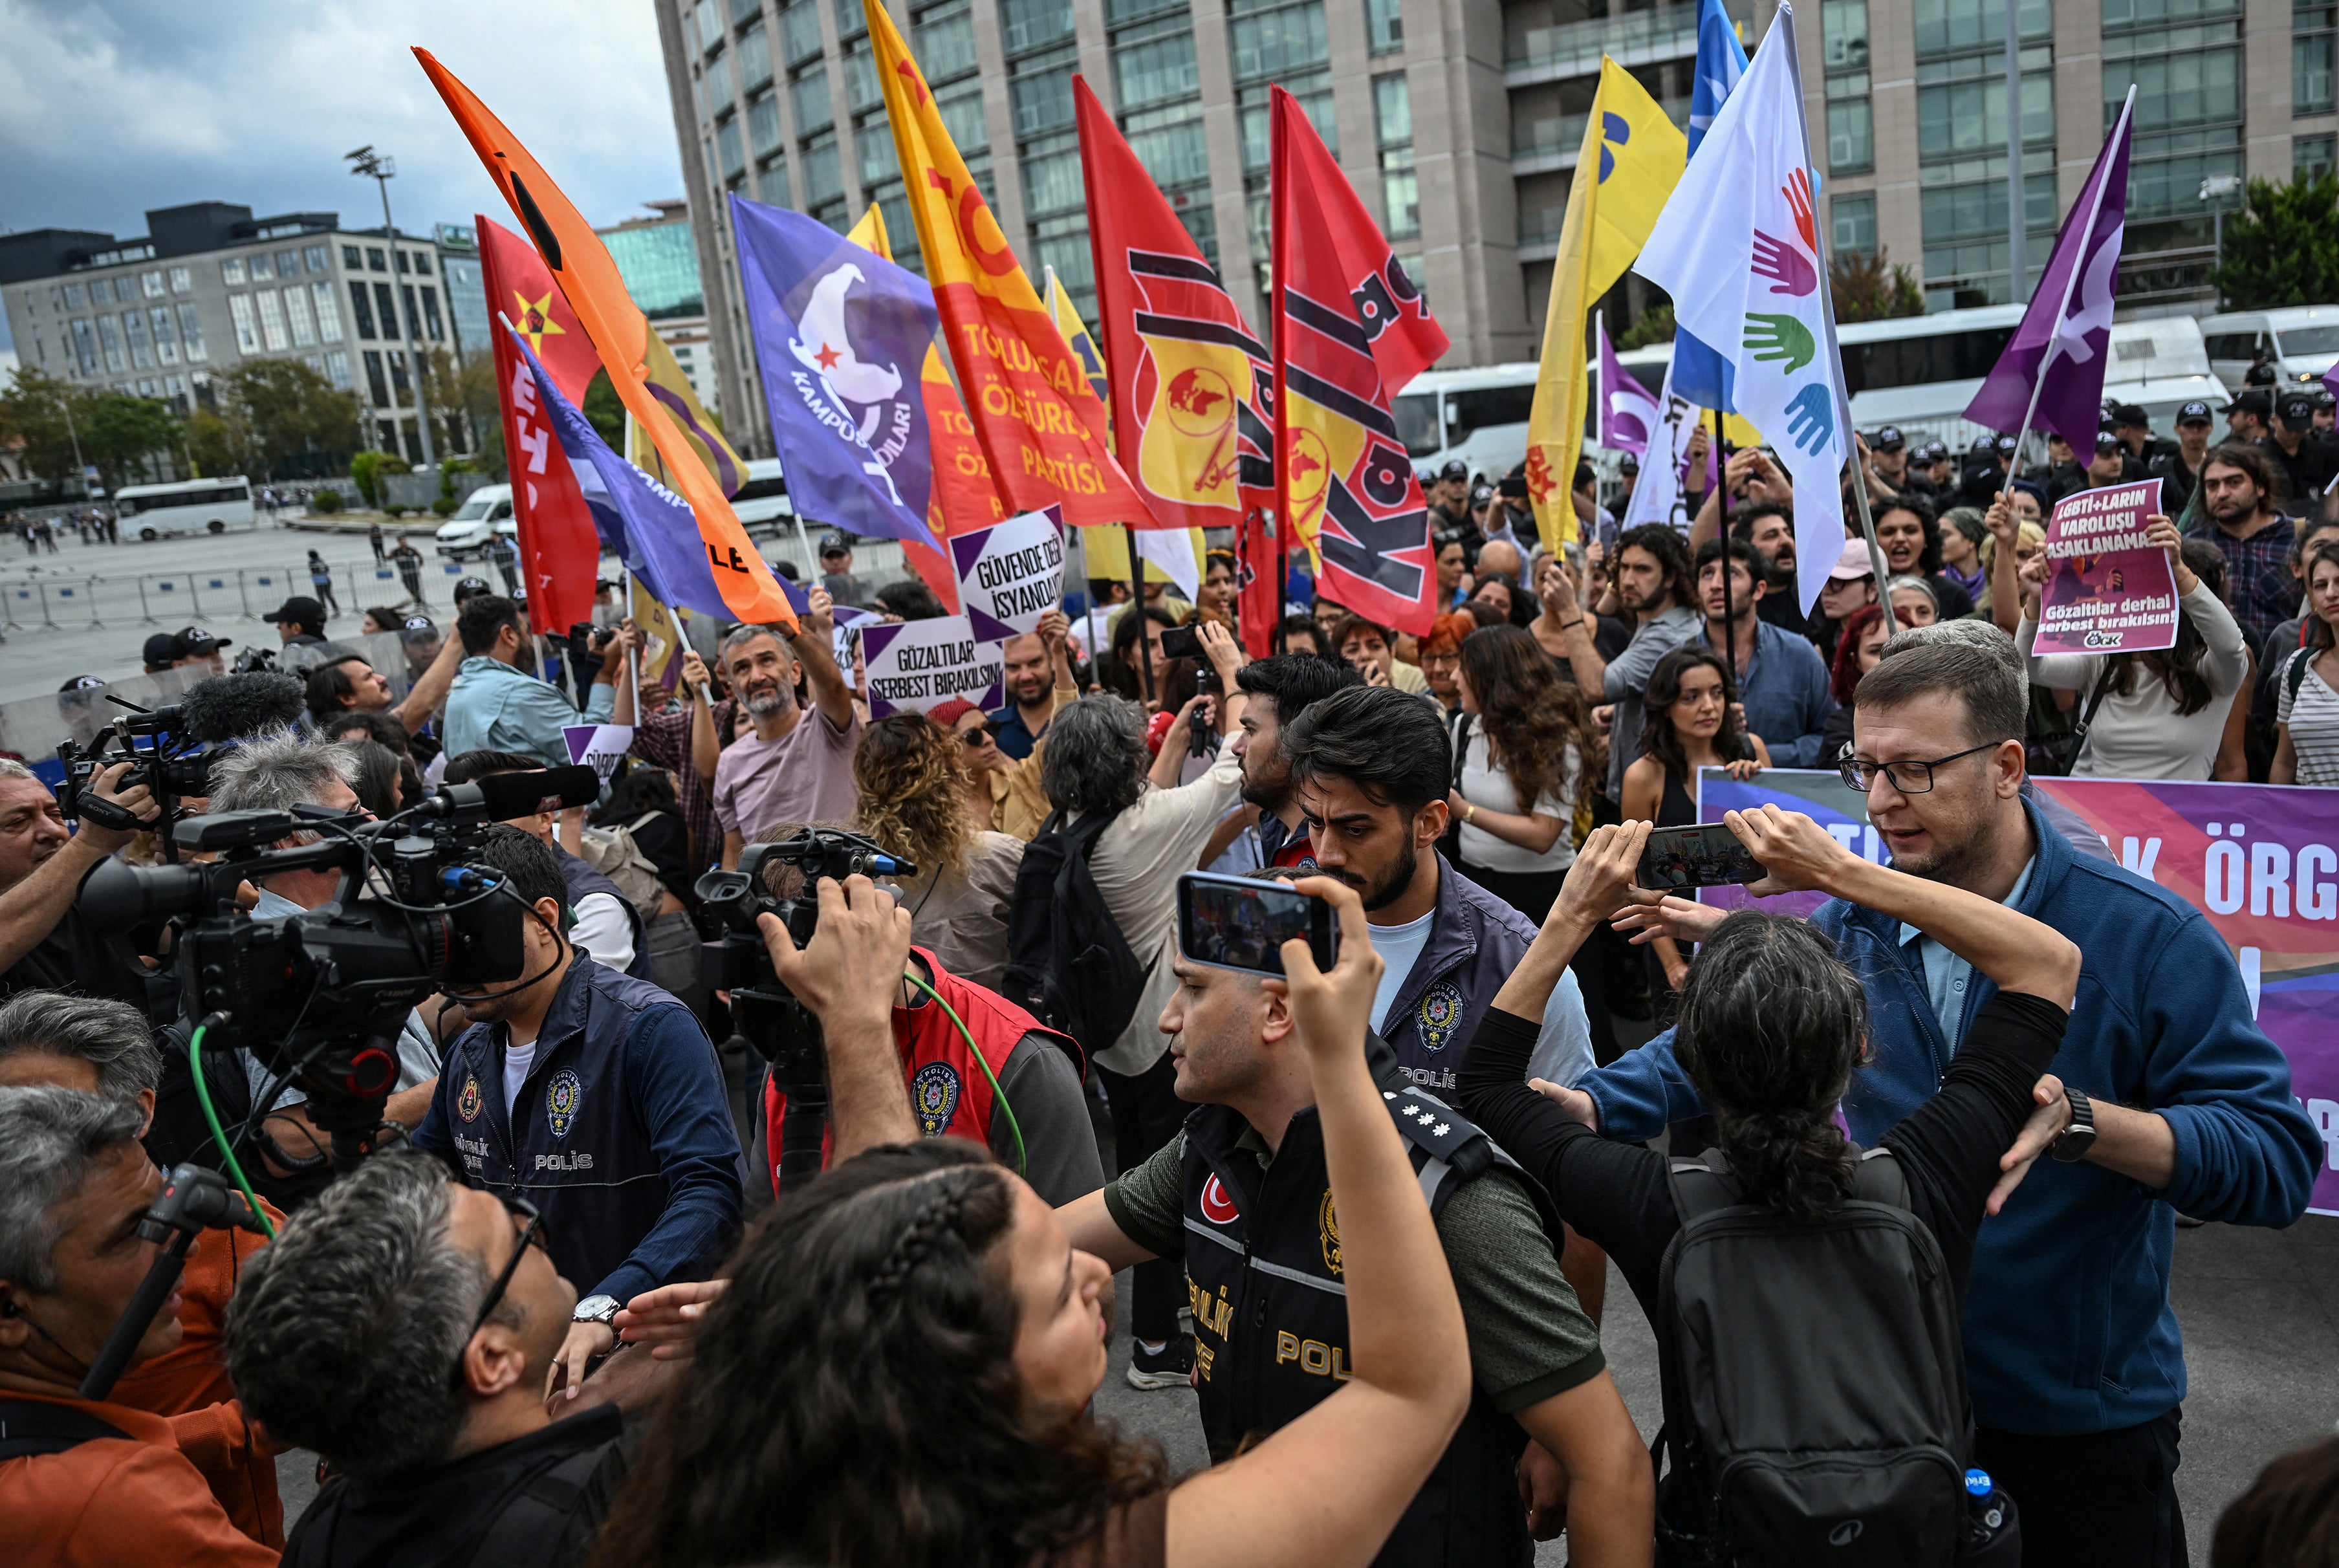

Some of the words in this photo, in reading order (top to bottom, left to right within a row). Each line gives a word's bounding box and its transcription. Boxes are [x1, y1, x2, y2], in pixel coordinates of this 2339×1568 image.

[875, 402, 911, 468] DILARI
[2057, 488, 2147, 521] LGBTİ+LARIN
[2060, 510, 2136, 538] VAROLUŞU
[2047, 532, 2155, 560] ASAKLANAMA
[977, 544, 1047, 590] GÜVENDE
[2045, 601, 2117, 620] Gözaltılar
[2120, 594, 2171, 613] derhal
[2039, 618, 2094, 633] serbest
[2098, 610, 2176, 630] bırakılsın!
[897, 639, 975, 672] GÖZALTILAR
[872, 675, 931, 701] SERBEST
[934, 662, 1001, 697] BIRAKILSIN!
[87, 803, 112, 816] SONY
[1433, 984, 1455, 996] OLİS
[556, 1072, 575, 1082] POLİS
[924, 1068, 950, 1078] POLİS
[535, 1150, 594, 1171] POLİS
[1188, 1278, 1234, 1343] ENLİK
[1276, 1329, 1354, 1382] POL
